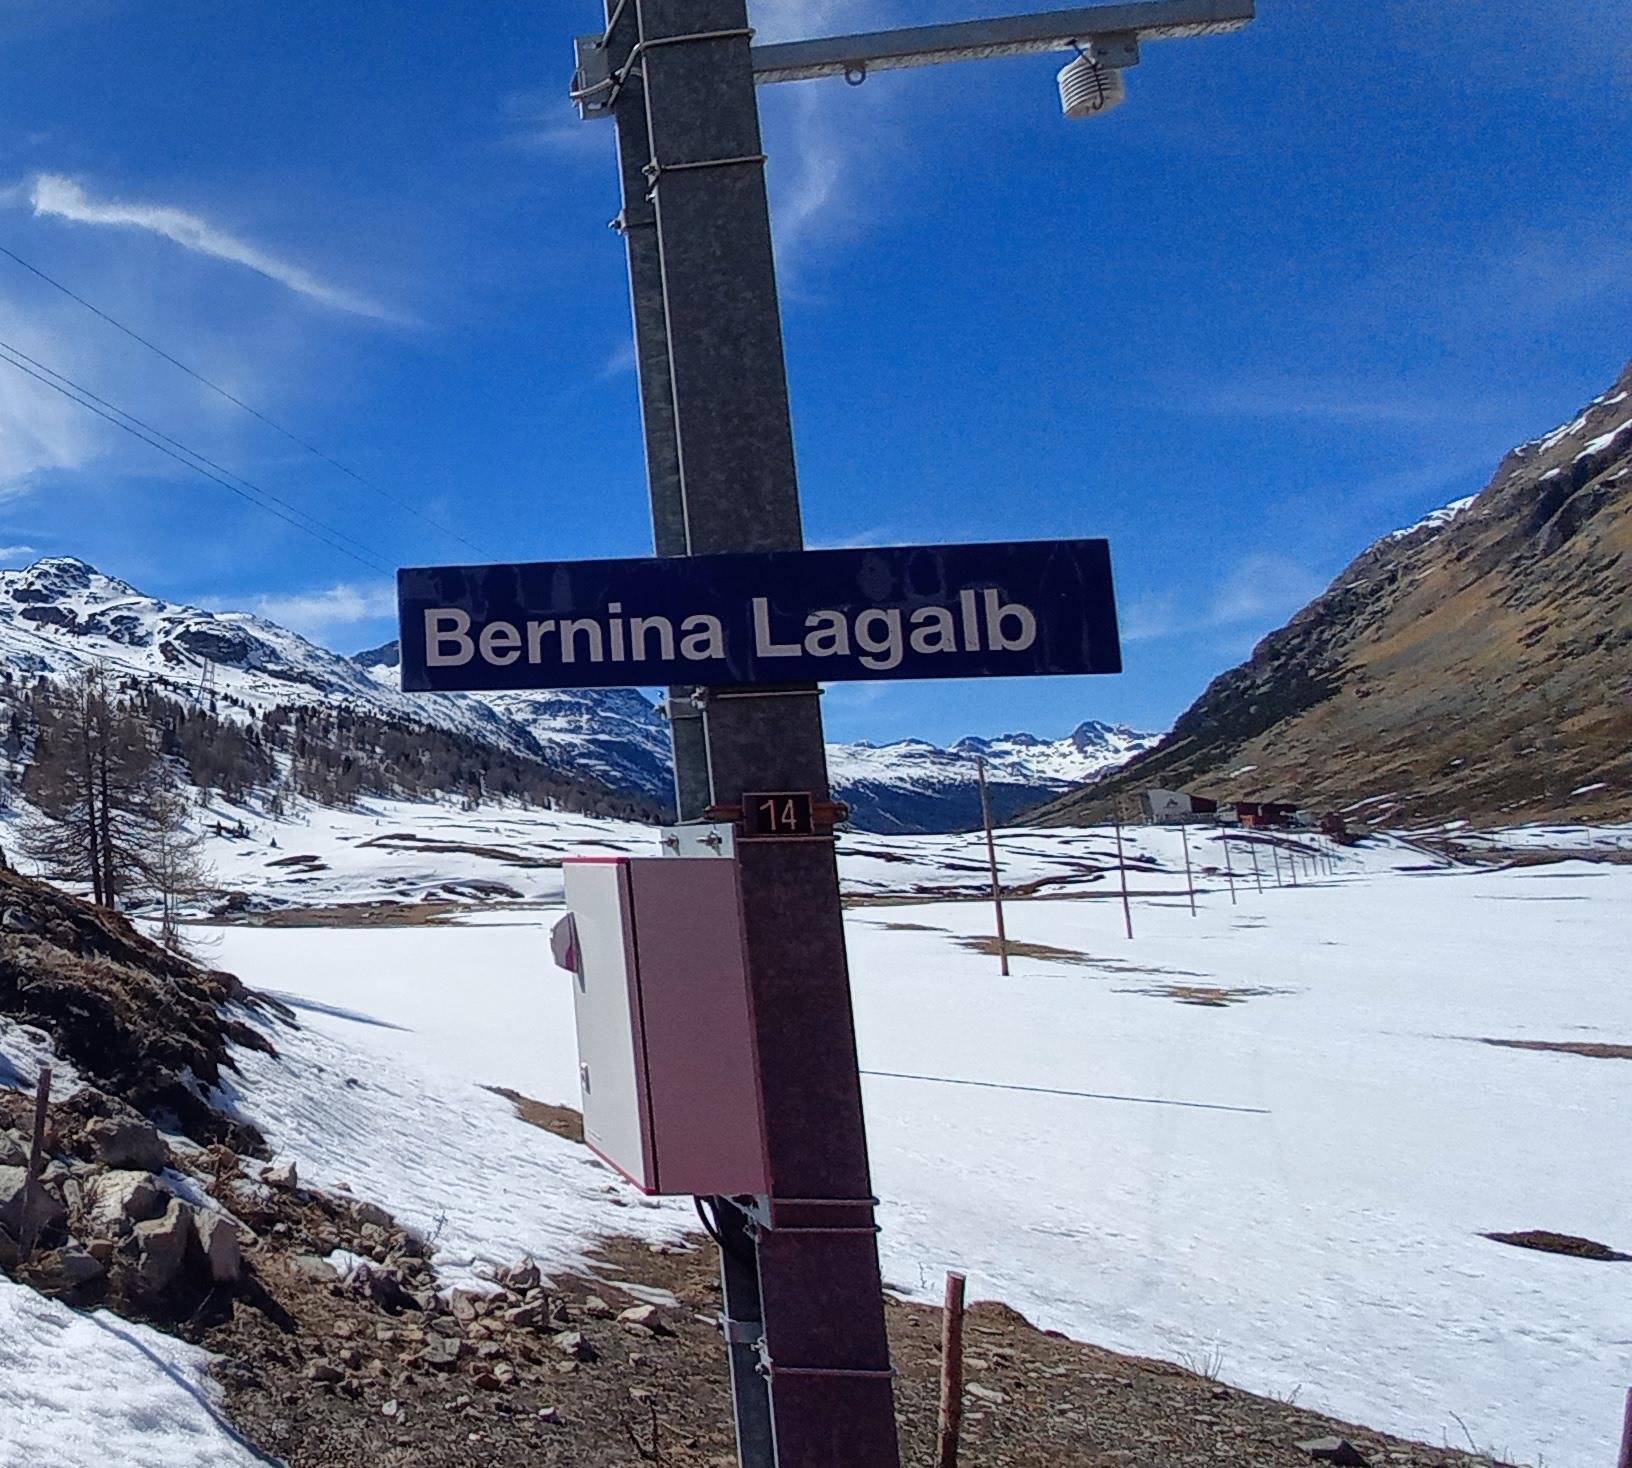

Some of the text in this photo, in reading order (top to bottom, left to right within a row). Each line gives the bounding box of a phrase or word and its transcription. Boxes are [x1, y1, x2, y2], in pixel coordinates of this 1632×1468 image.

[423, 587, 1038, 672] Bernina Lagalb
[759, 797, 798, 832] 14
